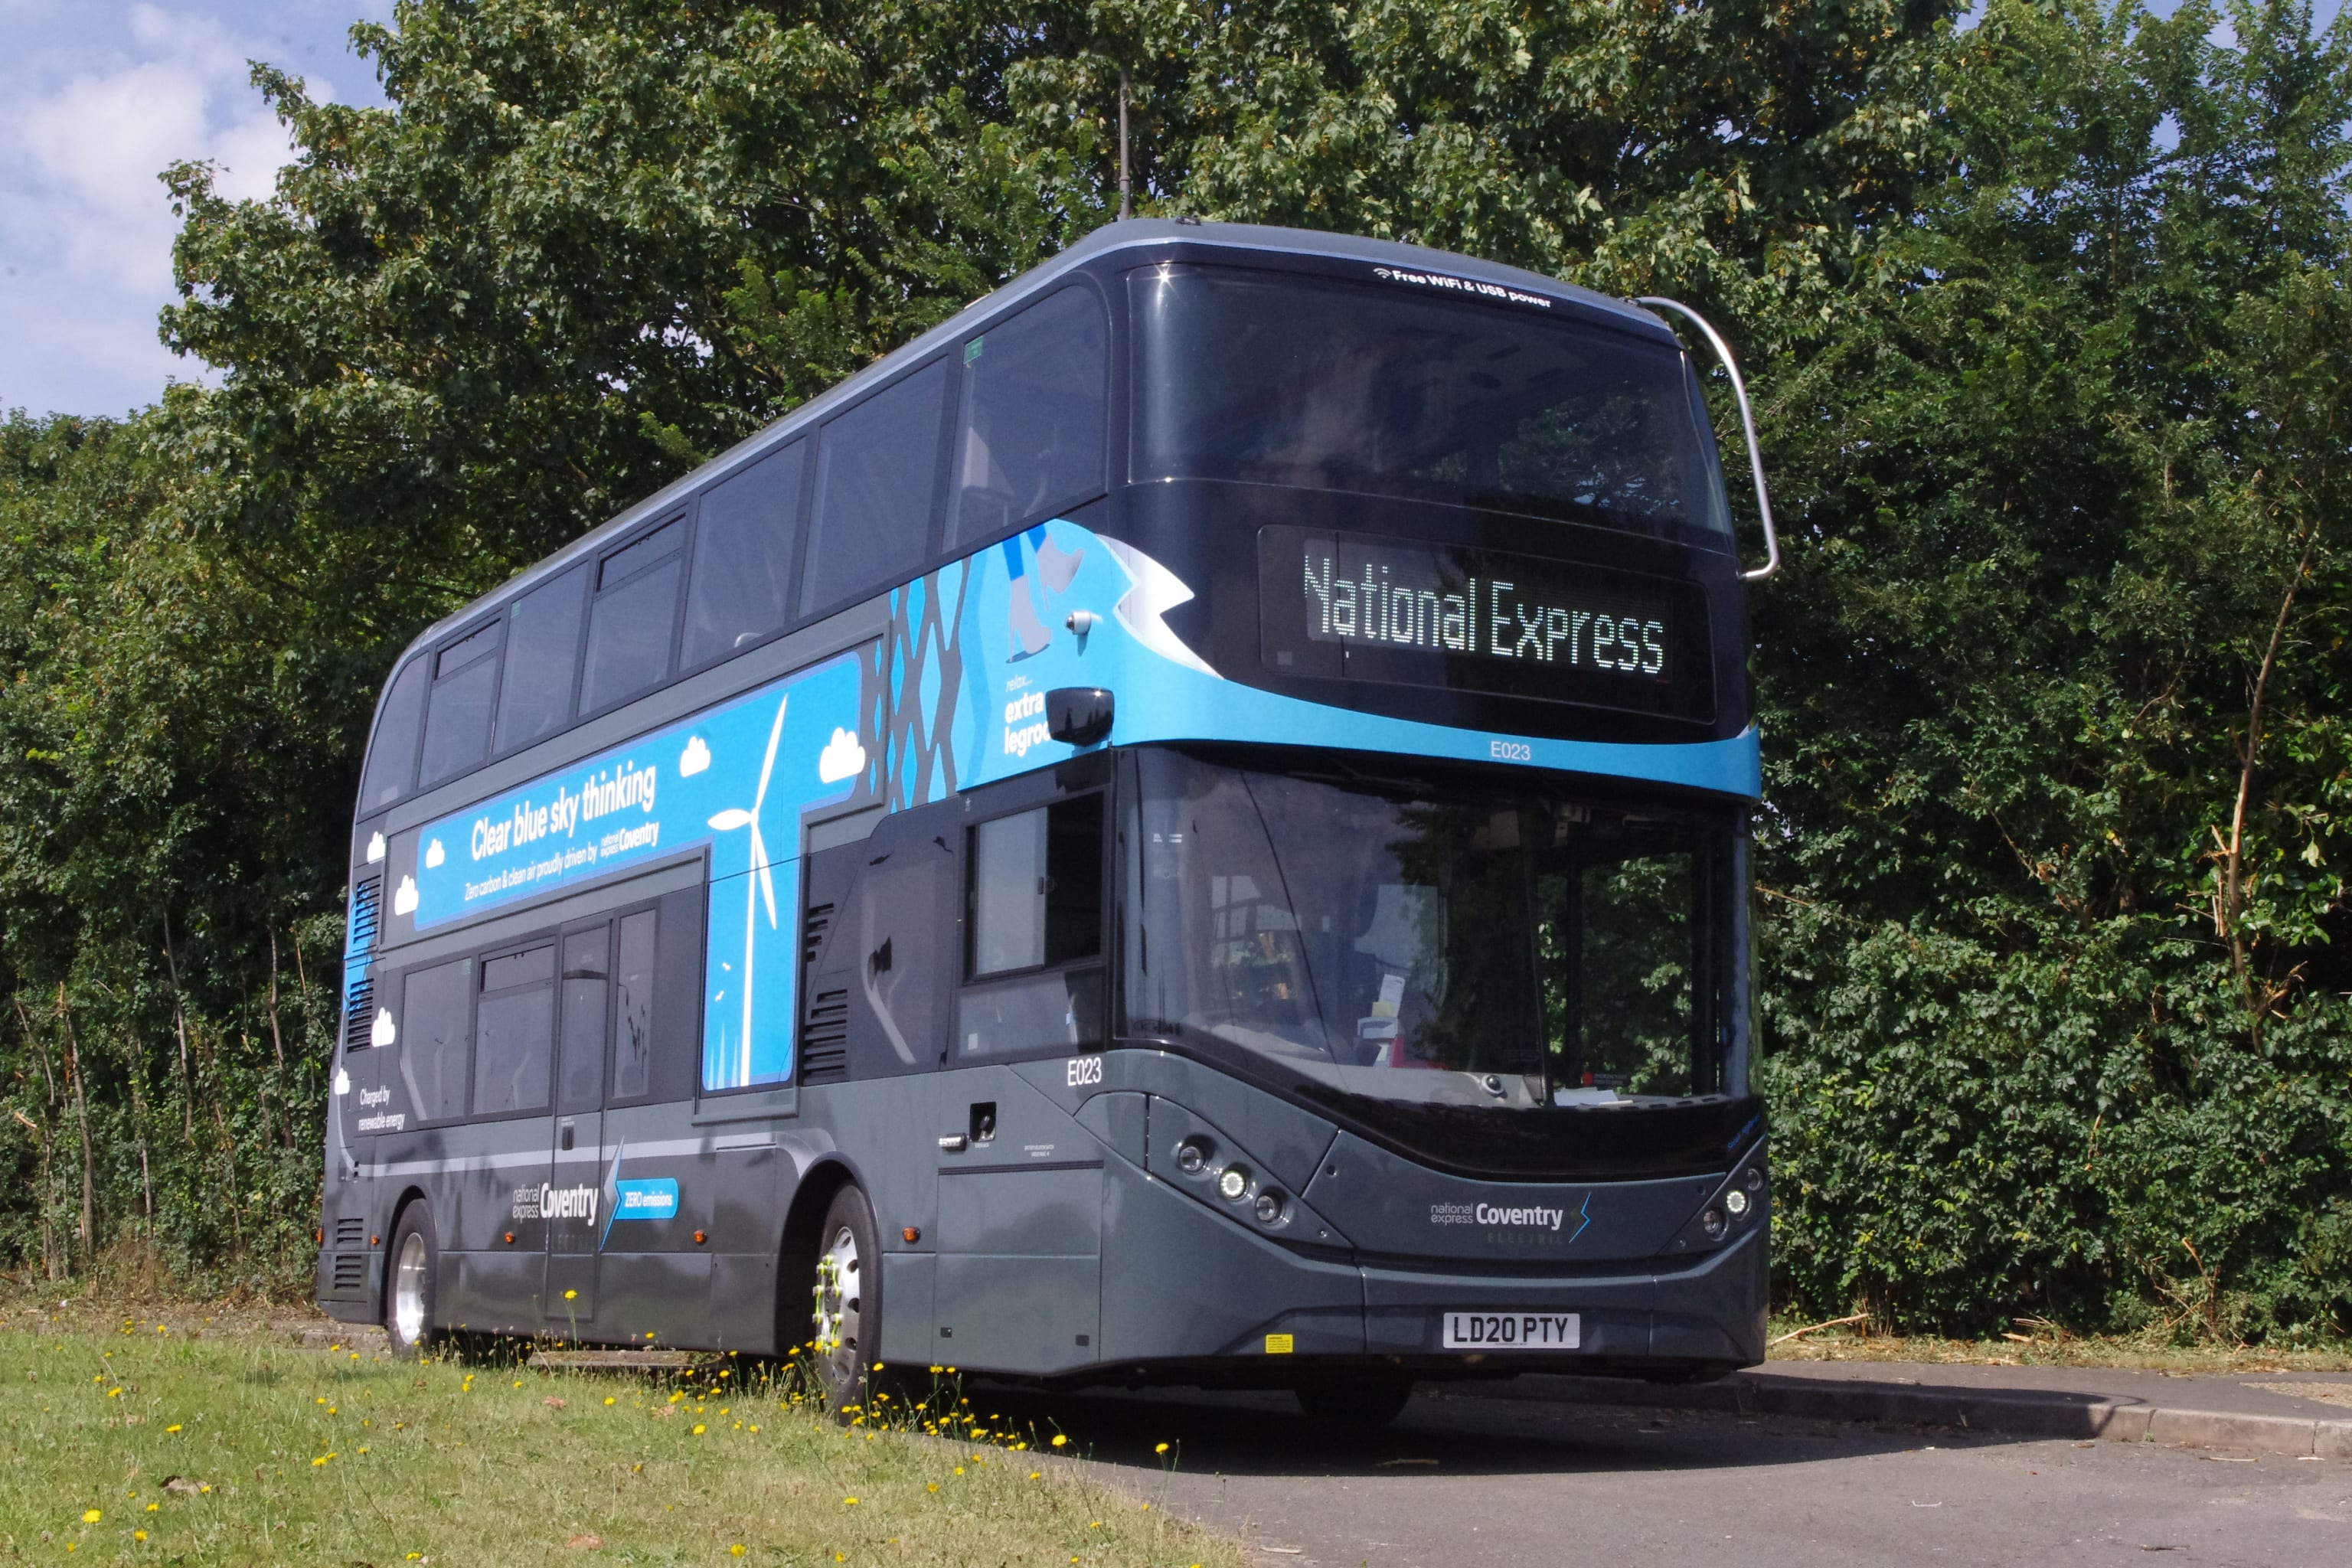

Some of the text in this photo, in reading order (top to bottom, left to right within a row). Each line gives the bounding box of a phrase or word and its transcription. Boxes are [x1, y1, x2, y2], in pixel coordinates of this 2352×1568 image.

[1391, 270, 1552, 309] Free WiFi & USB power
[1304, 555, 1664, 675] National Express
[1004, 691, 1044, 724] extra
[1004, 720, 1051, 757] legroo
[1491, 740, 1531, 761] E023
[471, 760, 657, 861] Clear blue sky thinking
[619, 822, 659, 851] Coventry
[464, 841, 598, 901] Zero carbon & clean air proudly driven by
[1067, 1057, 1102, 1086] E023
[360, 1085, 390, 1108] Charged by
[358, 1111, 405, 1132] renewable energy
[513, 1184, 540, 1203] national
[540, 1182, 599, 1227] Coventry
[625, 1191, 673, 1207] ZERO emissions
[512, 1203, 539, 1223] express
[1430, 1202, 1473, 1214] national
[1430, 1214, 1473, 1226] express
[1476, 1203, 1563, 1231] Coventry
[1453, 1316, 1568, 1343] LD20 PTY
